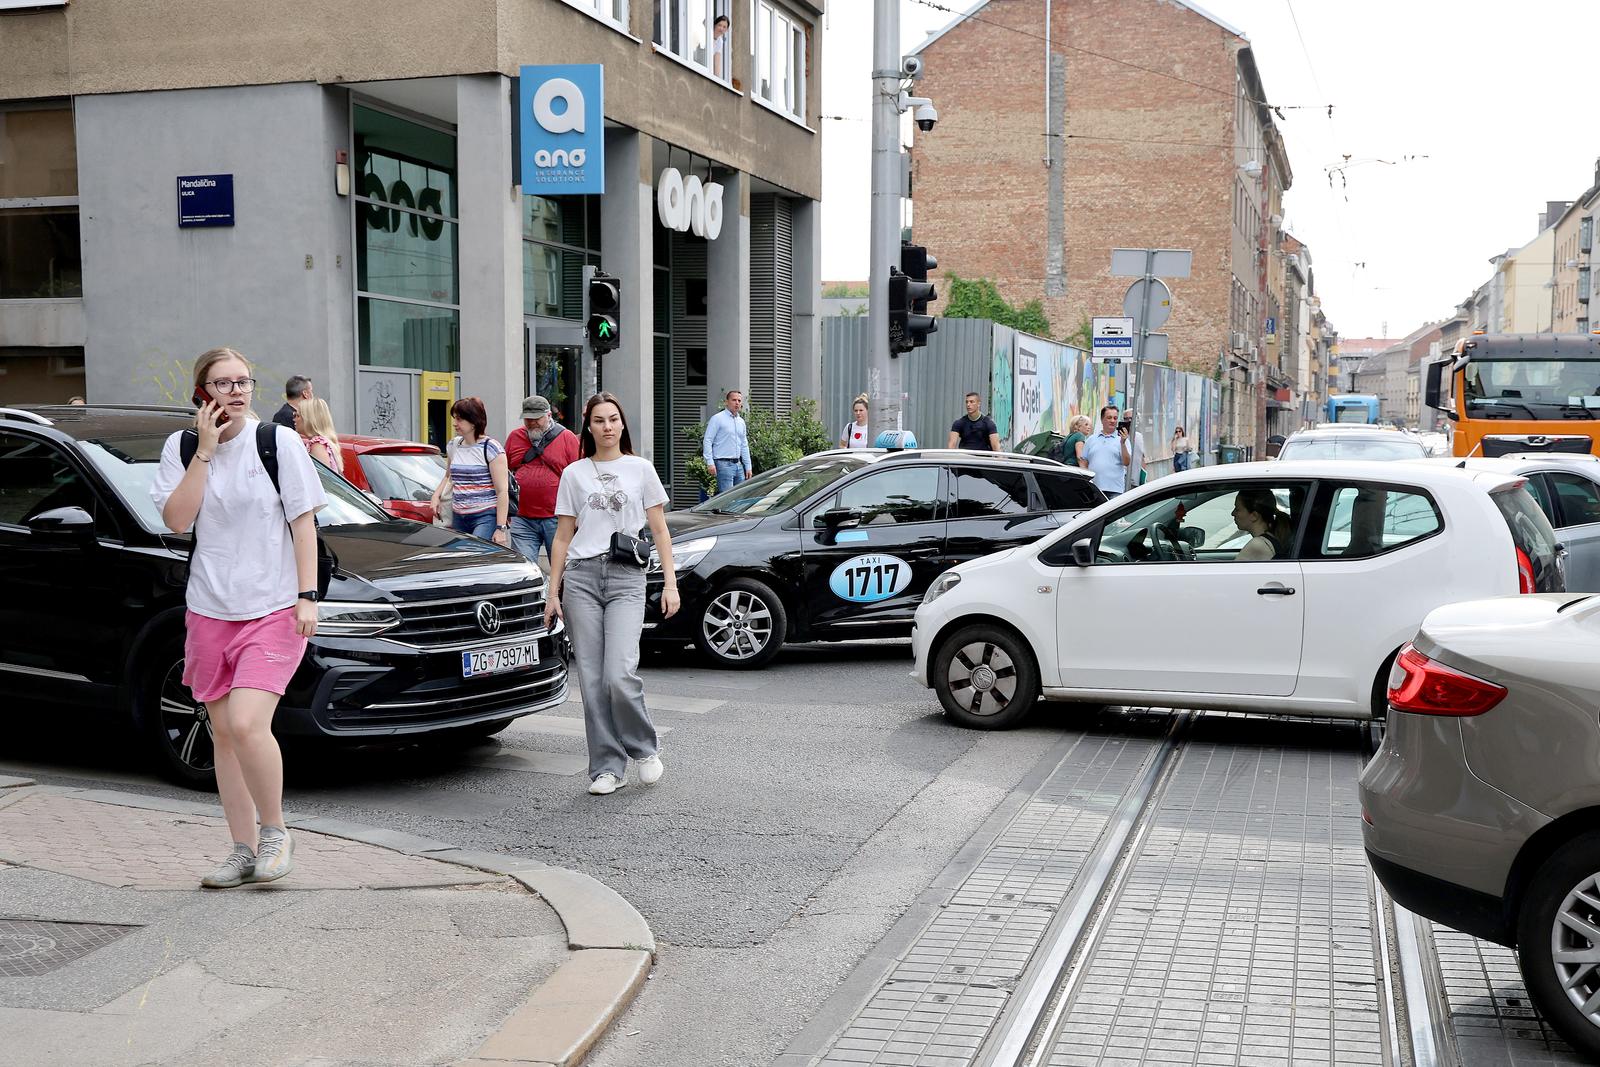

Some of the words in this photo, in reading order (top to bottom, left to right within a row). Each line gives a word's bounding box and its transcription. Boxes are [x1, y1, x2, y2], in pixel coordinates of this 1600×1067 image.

[181, 178, 216, 188] Mandaličina
[1020, 380, 1041, 419] Osjeti
[860, 556, 881, 566] TAXI
[844, 563, 899, 597] 1717
[472, 652, 487, 672] ZG
